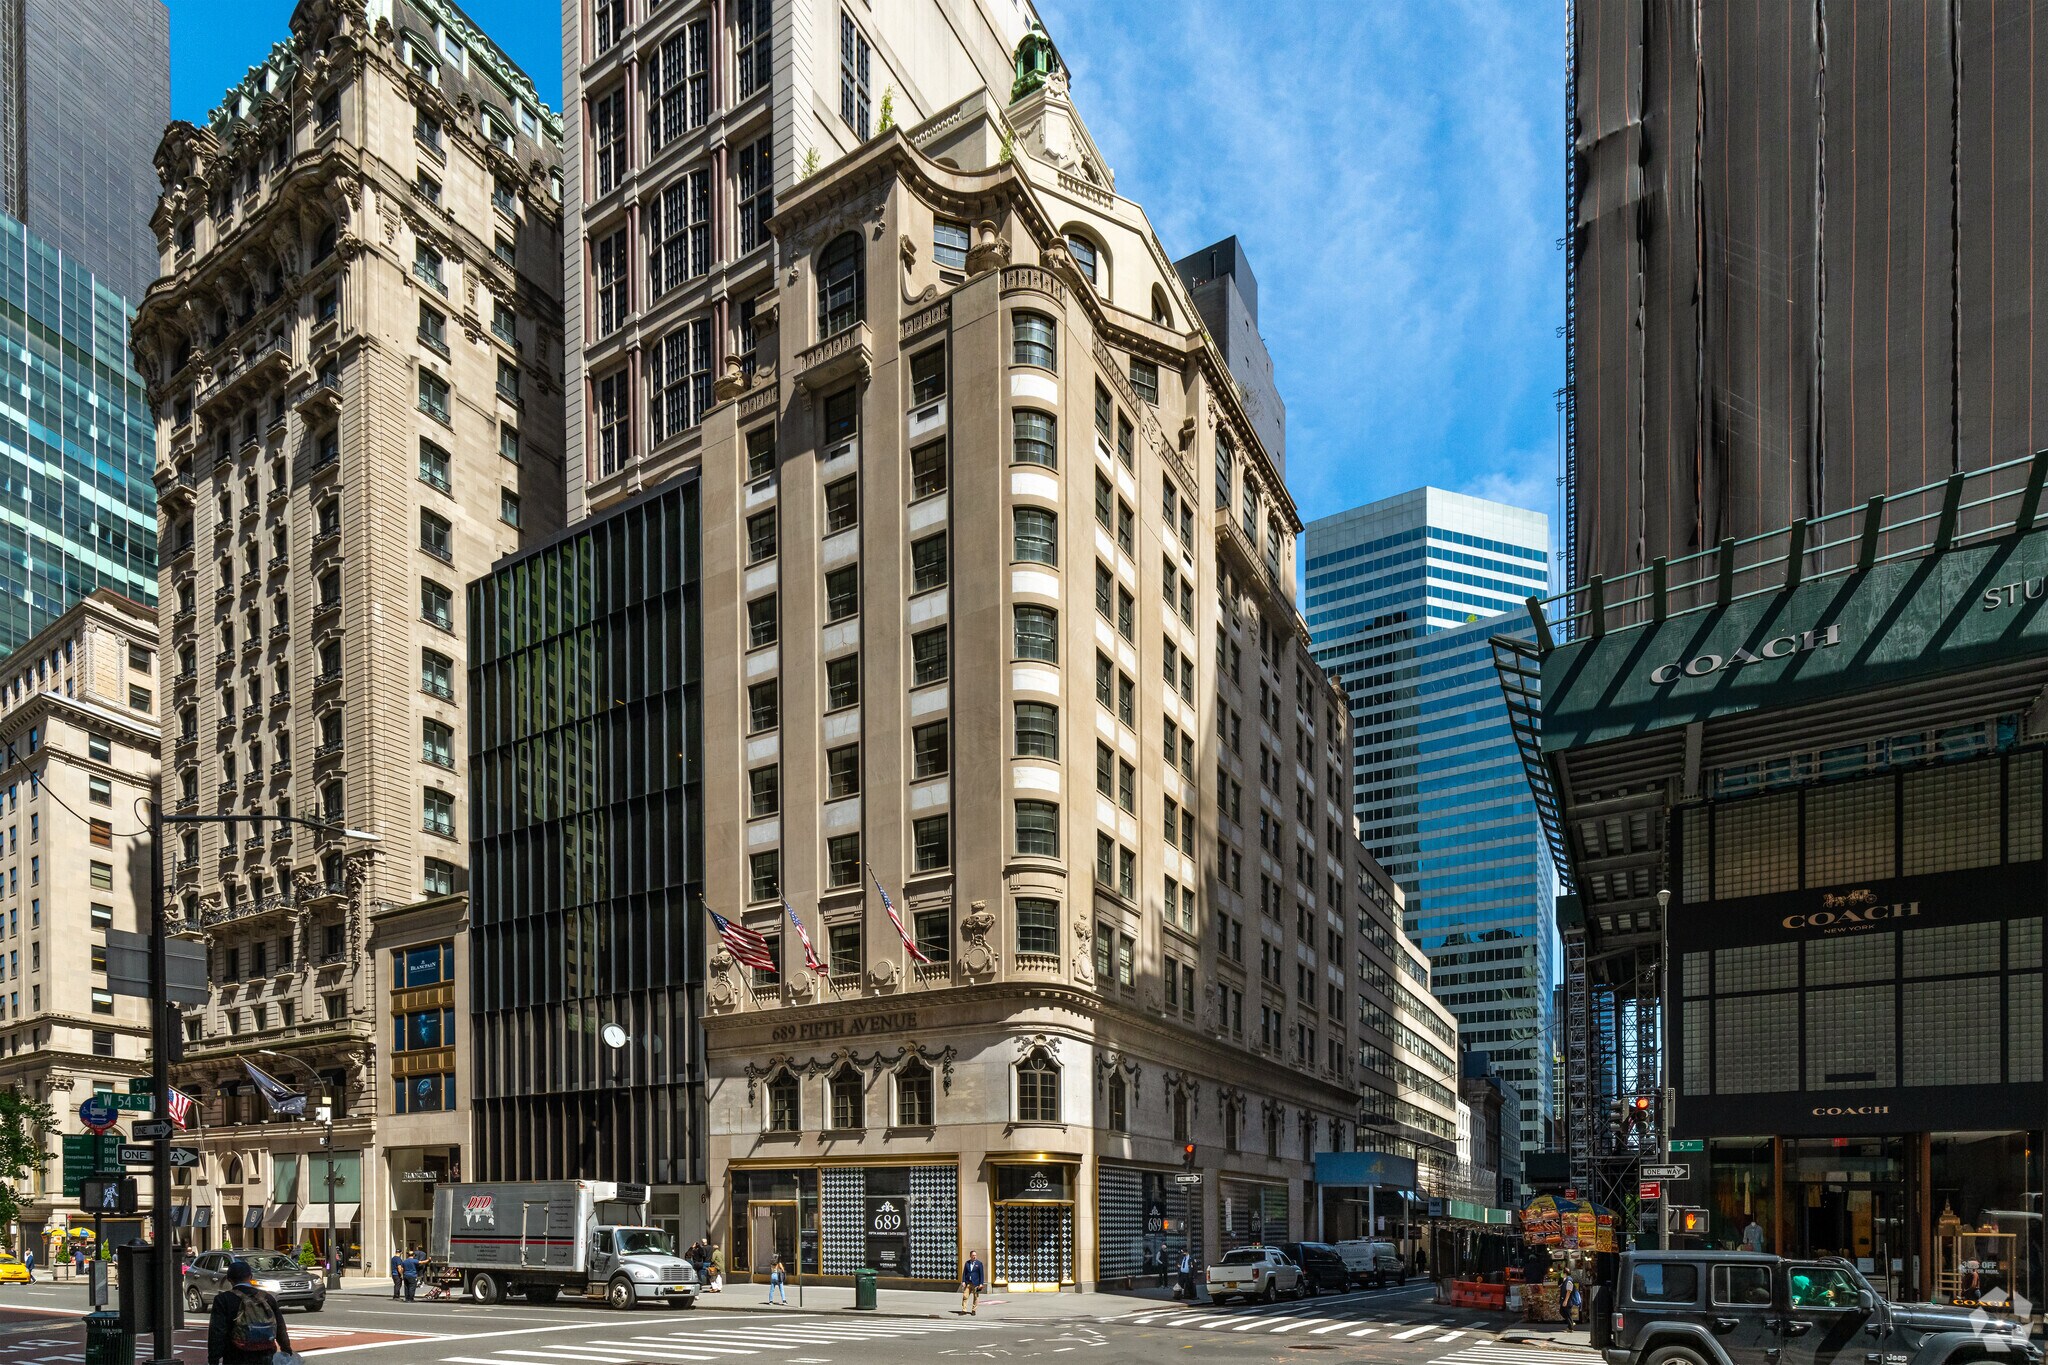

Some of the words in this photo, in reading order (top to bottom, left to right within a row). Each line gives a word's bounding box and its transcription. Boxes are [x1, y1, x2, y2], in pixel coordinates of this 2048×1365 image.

[1983, 576, 2045, 611] STU
[1650, 623, 1842, 685] COACH
[1782, 901, 1921, 929] COACH
[1849, 923, 1875, 931] YORK
[410, 961, 437, 971] BLANCPAIN
[772, 1024, 797, 1041] 689
[800, 1018, 845, 1039] FIFTH
[850, 1012, 918, 1034] AVENUE
[103, 1094, 113, 1107] W
[117, 1096, 132, 1108] 54
[136, 1097, 146, 1105] St
[1812, 1106, 1889, 1116] COACH
[134, 1125, 148, 1136] ONE
[153, 1123, 168, 1134] WAY
[1679, 1141, 1685, 1150] 5
[123, 1150, 148, 1160] ONE
[170, 1152, 188, 1161] AY
[1029, 1179, 1049, 1189] 689
[874, 1214, 901, 1230] 689
[1148, 1217, 1162, 1232] 689
[1981, 1261, 1997, 1269] OFF
[1952, 1299, 2011, 1307] COACH
[1886, 1353, 1908, 1363] Jeep
